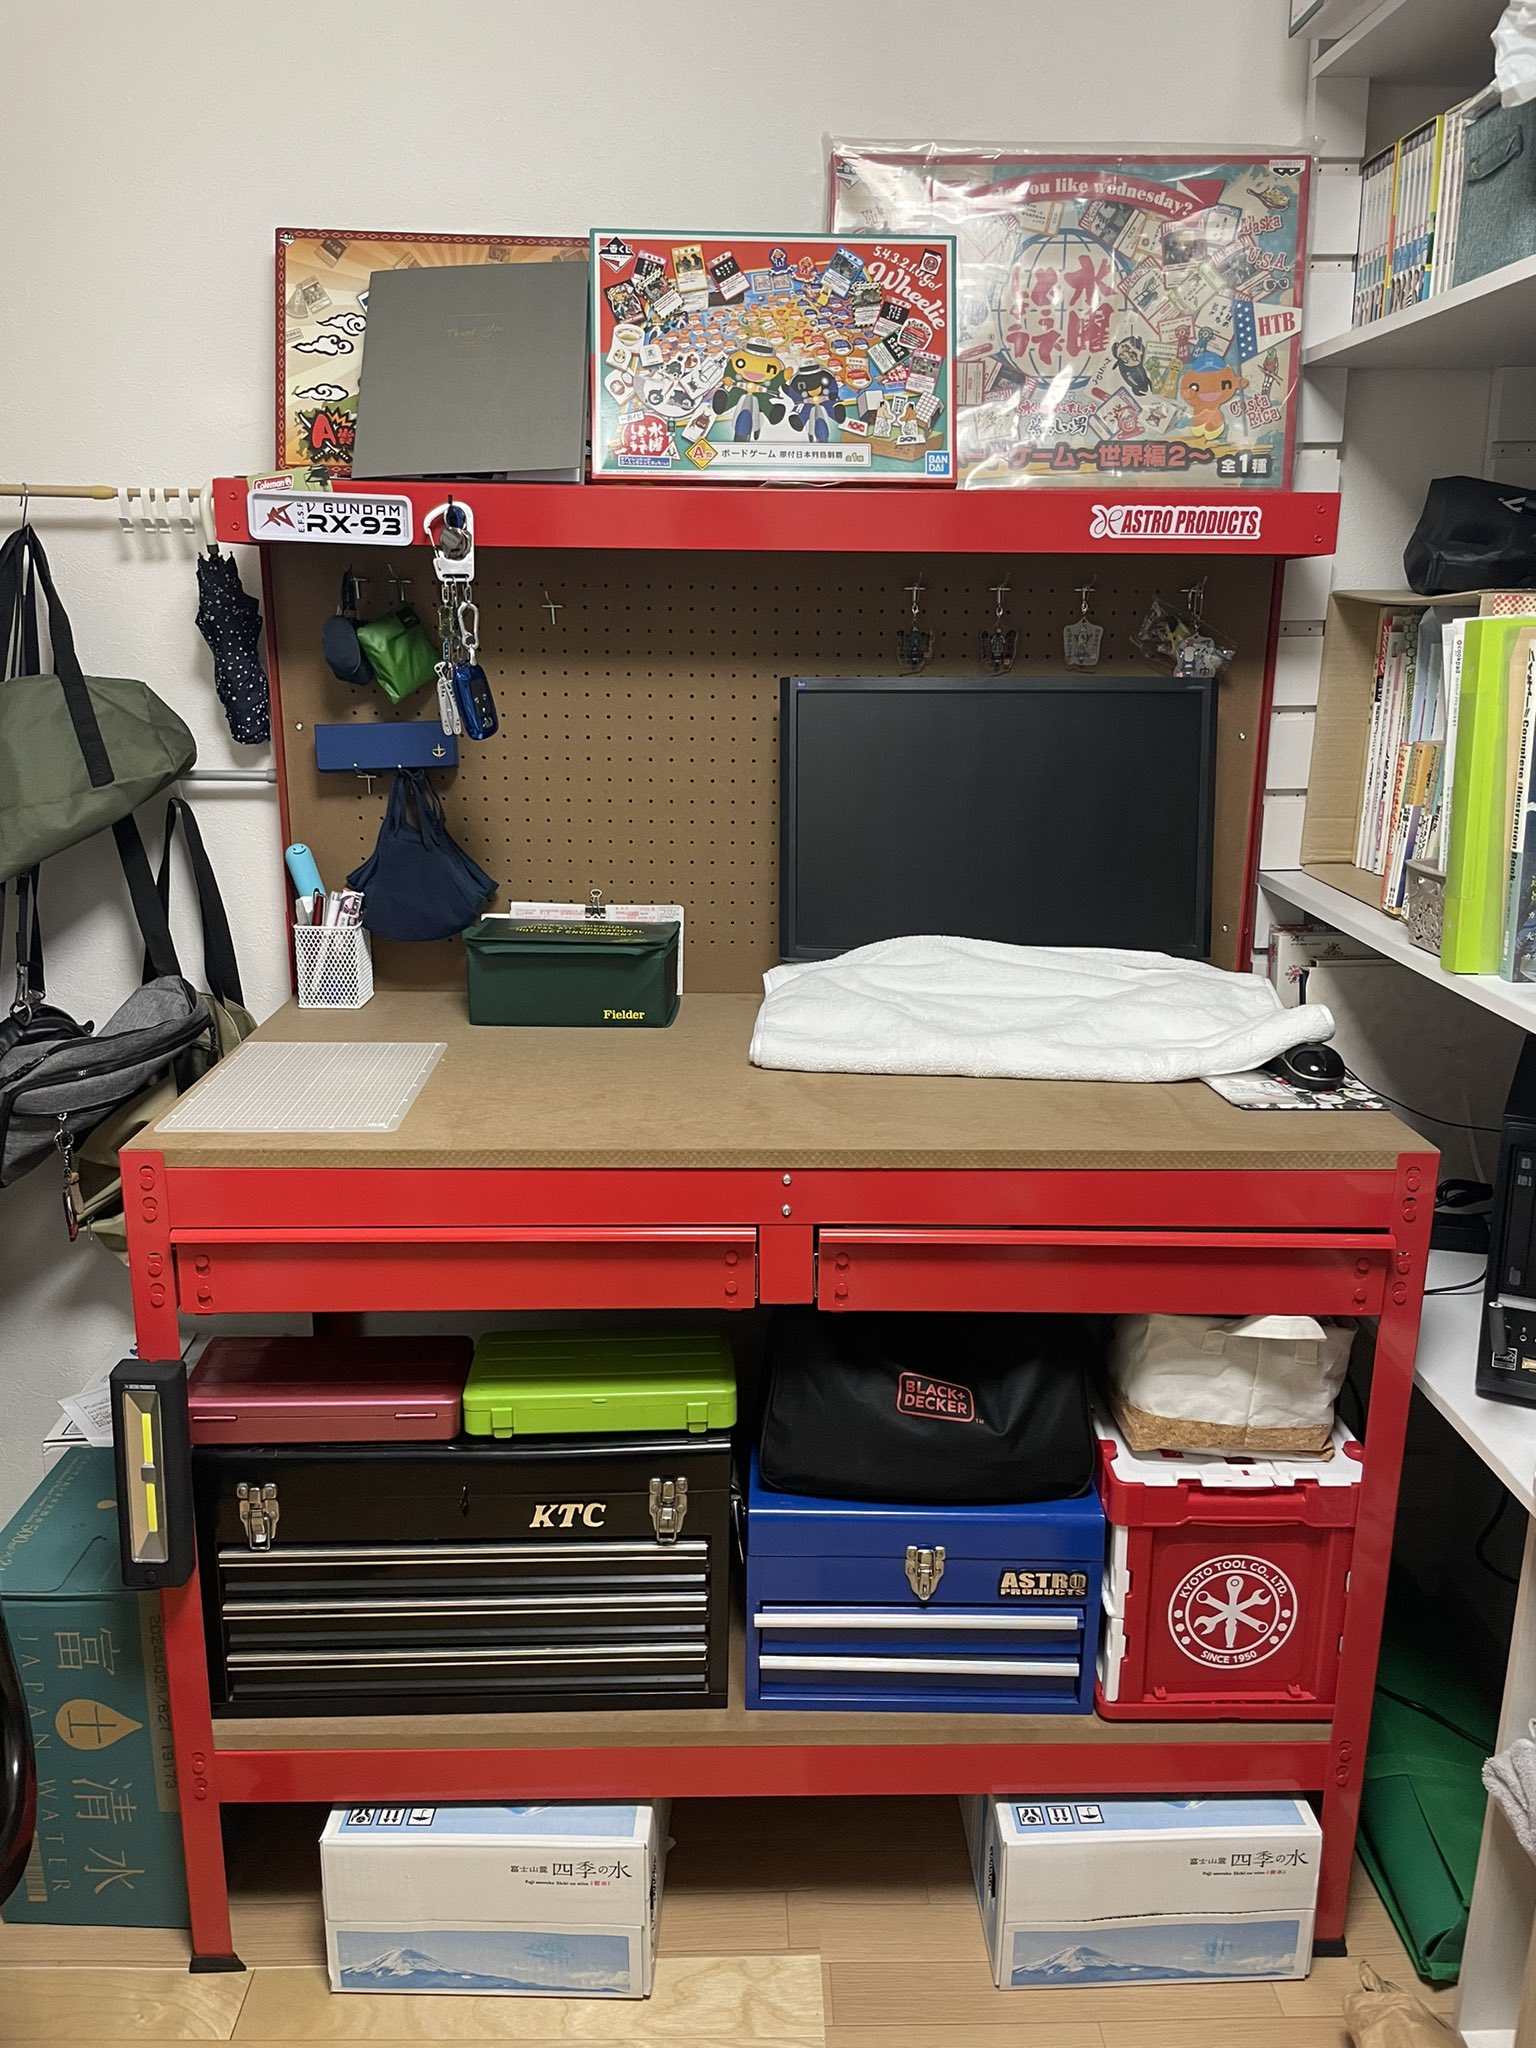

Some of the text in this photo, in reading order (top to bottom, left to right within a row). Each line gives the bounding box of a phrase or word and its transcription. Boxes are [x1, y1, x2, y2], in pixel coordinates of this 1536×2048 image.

[1055, 177, 1089, 193] like
[1093, 178, 1195, 216] wednesday?
[1240, 215, 1282, 234] Alaska
[1247, 246, 1290, 271] U.S.A.
[867, 261, 946, 331] Wheelie
[1257, 311, 1296, 337] HTB
[1249, 407, 1282, 430] Rica
[721, 448, 776, 459] ボードゲーム
[928, 453, 949, 463] BAN
[928, 463, 945, 473] DAI
[255, 477, 286, 491] Coleman
[323, 502, 401, 517] GUNDAM
[306, 514, 402, 537] RX-93
[1120, 509, 1259, 534] ASTRO PRODUCTS
[1518, 719, 1530, 778] Complete
[603, 1009, 645, 1020] Fielder
[905, 1380, 966, 1400] BLACK+
[904, 1393, 967, 1414] DECKER
[529, 1502, 607, 1528] KTC
[1000, 1572, 1087, 1589] ASTRO
[1179, 1567, 1213, 1599] KYOTO
[1214, 1560, 1247, 1572] TOOL
[1270, 1575, 1288, 1598] LTD.
[1000, 1588, 1087, 1596] PRODUCTS
[1200, 1650, 1258, 1664] SINCE 1950
[17, 1632, 51, 1749] JAPAN
[54, 1627, 145, 1895] 富士清水
[37, 1779, 72, 1892] WATER
[1230, 1849, 1309, 1868] 四季の水
[552, 1860, 633, 1879] 四季の水
